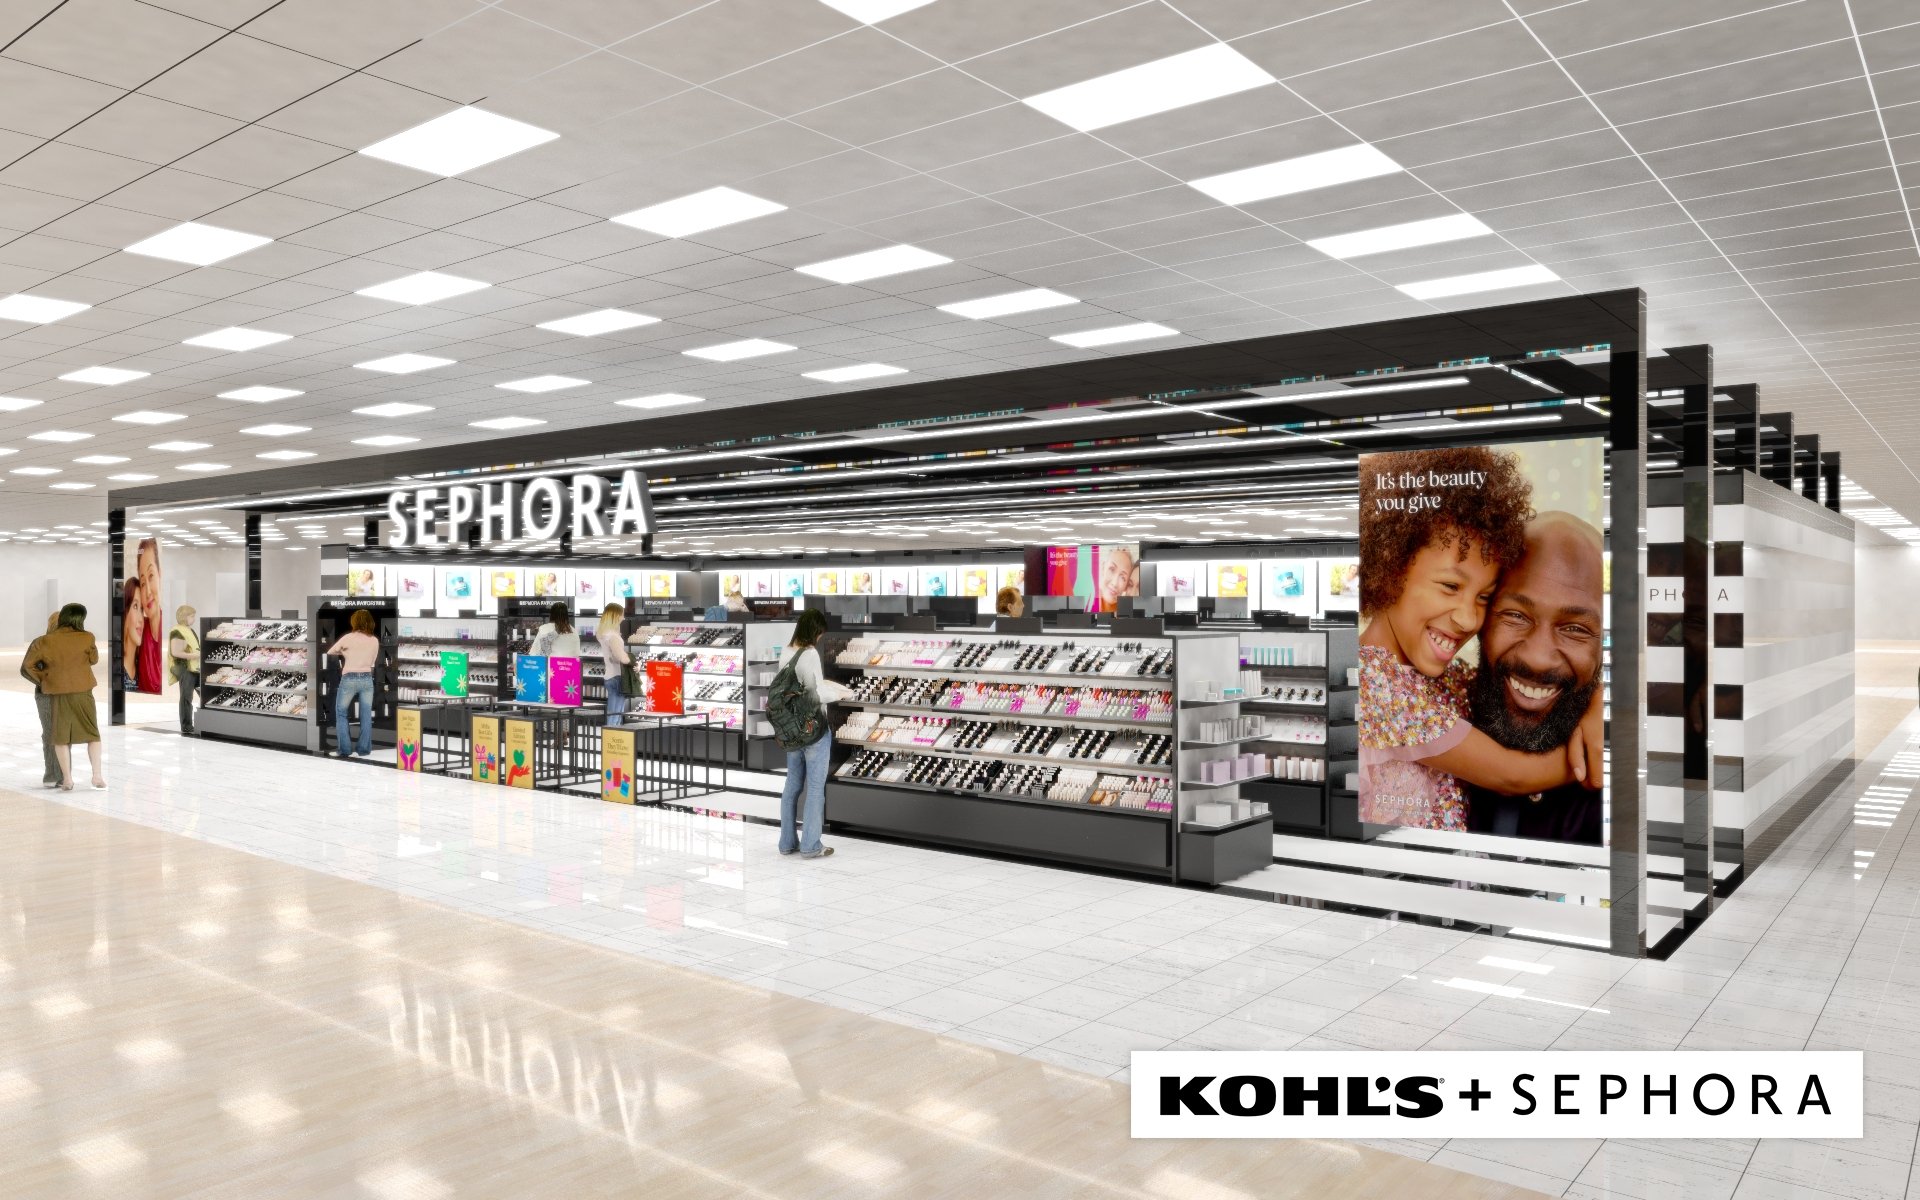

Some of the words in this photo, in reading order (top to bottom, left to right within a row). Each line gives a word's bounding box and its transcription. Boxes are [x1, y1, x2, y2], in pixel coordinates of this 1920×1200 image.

[1376, 472, 1395, 490] It's
[1400, 472, 1426, 488] the
[1429, 470, 1488, 489] beauty
[388, 470, 652, 548] SEPHORA
[1375, 498, 1405, 514] you
[1409, 493, 1441, 514] give
[1375, 794, 1431, 808] SEPHORA
